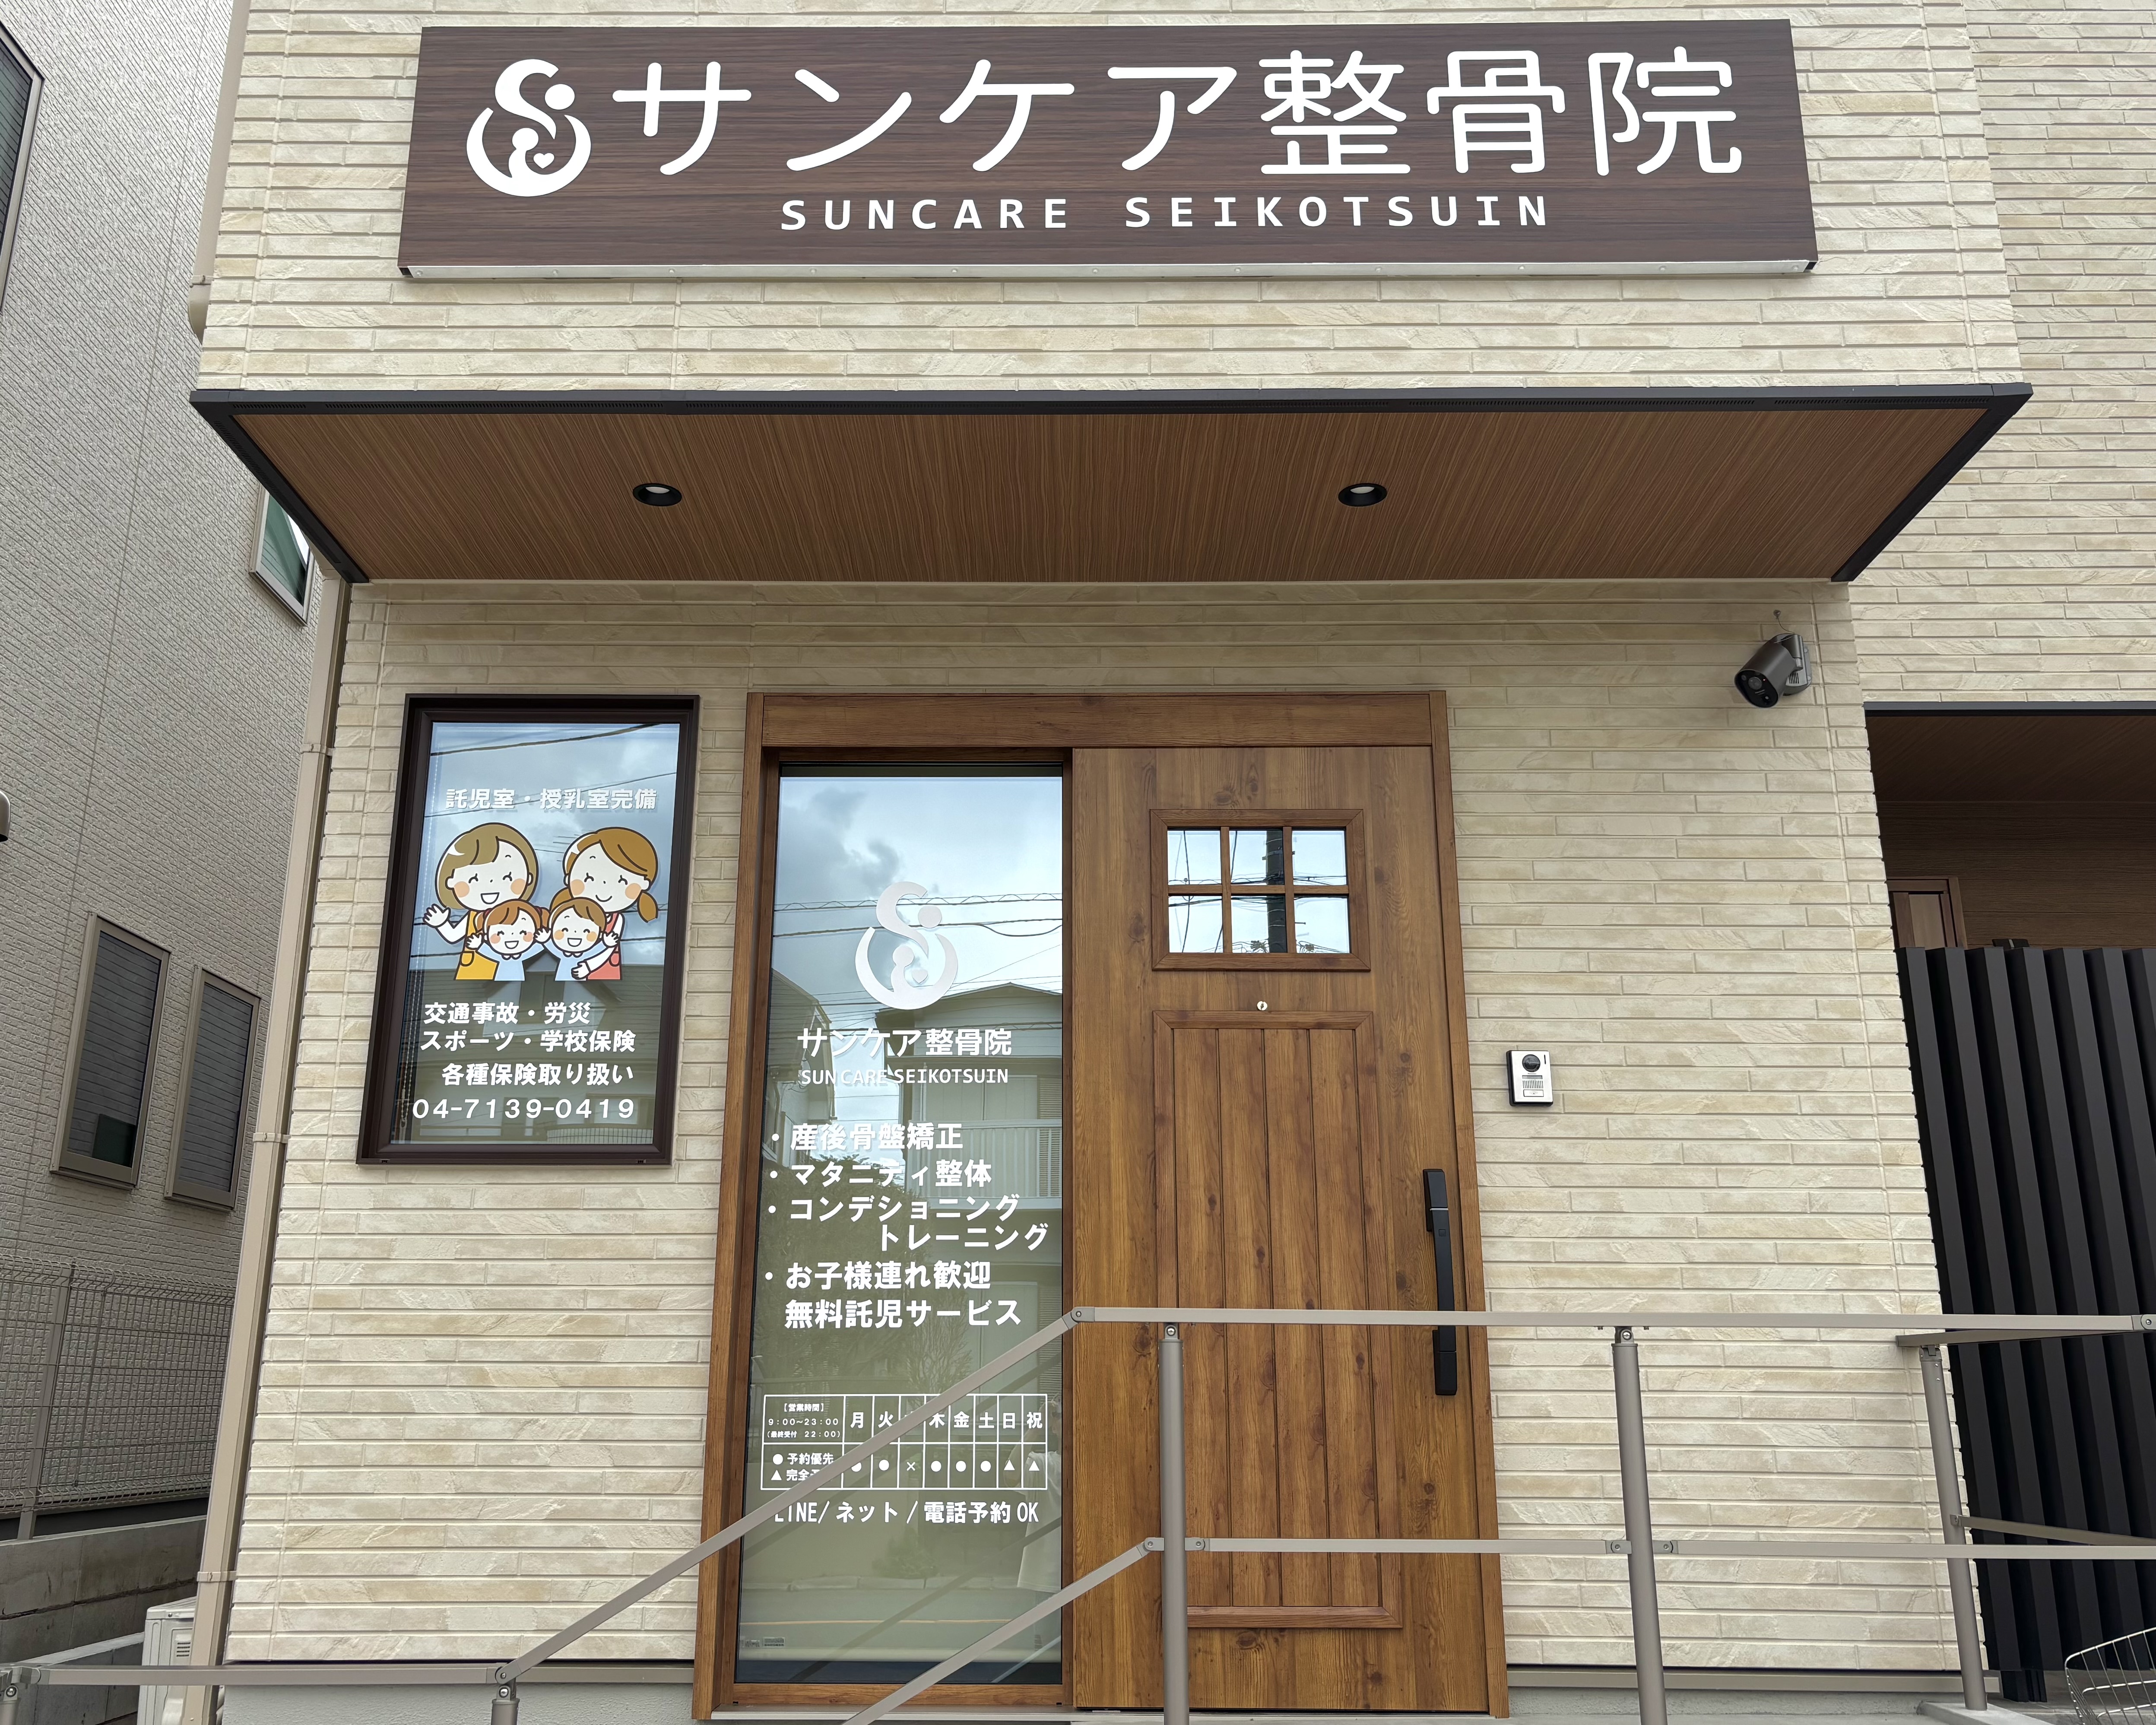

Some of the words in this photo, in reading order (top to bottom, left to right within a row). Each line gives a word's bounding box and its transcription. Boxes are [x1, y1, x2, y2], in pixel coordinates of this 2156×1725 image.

[612, 46, 1742, 176] サンケア整骨院
[781, 198, 1066, 231] SUNCARE
[1125, 195, 1546, 228] SEIKOTSUIN
[445, 788, 657, 809] 託児室・授乳室完備
[423, 1002, 591, 1025] 交通事故・労災
[420, 1029, 636, 1053] スポーツ・学校保険
[797, 1027, 1012, 1057] サンケア整骨院
[441, 1062, 634, 1086] 各種保険取り扱い
[894, 1069, 1008, 1084] SEIKOTSUIN
[412, 1098, 634, 1119] 04-7139-0419
[881, 1223, 1049, 1252] トレーニング
[784, 1299, 1021, 1329] 無料託児サービス
[850, 1412, 864, 1428] 月
[878, 1411, 893, 1428] 火
[929, 1413, 945, 1428] 木
[953, 1411, 970, 1428] 金
[978, 1412, 995, 1428] 土
[1003, 1412, 1015, 1429] 日
[1026, 1411, 1043, 1429] 祝
